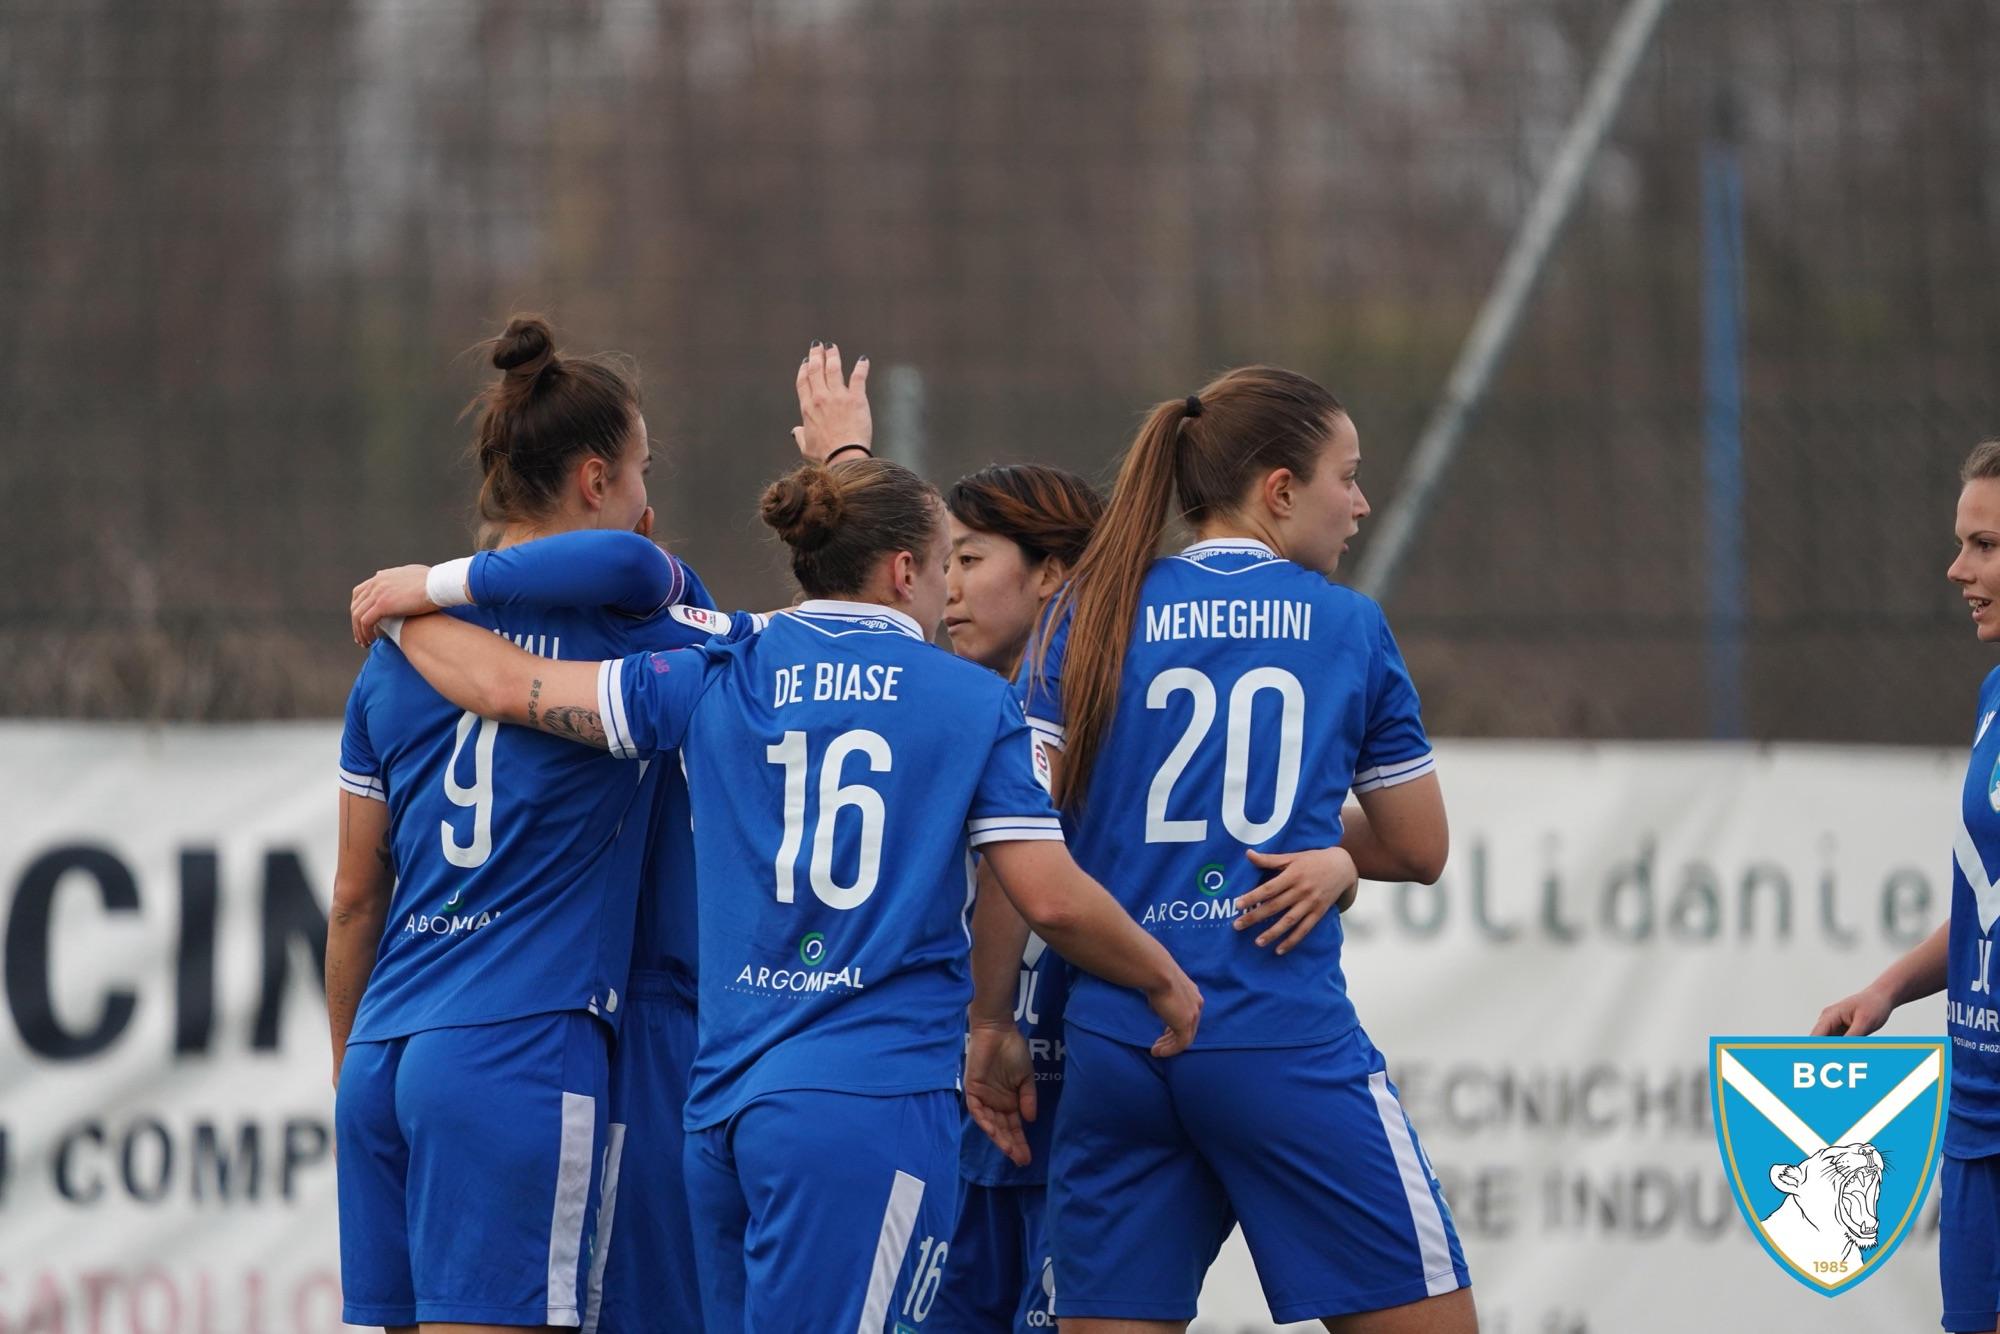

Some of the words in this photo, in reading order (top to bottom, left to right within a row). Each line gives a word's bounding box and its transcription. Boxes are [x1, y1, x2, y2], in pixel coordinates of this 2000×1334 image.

[1146, 601, 1311, 642] MENEGHINI
[774, 667, 803, 708] DE
[816, 664, 903, 701] BIASE
[441, 711, 499, 868] 9
[1145, 666, 1306, 846] 20
[766, 729, 893, 911] 16
[52, 1114, 333, 1211] COMP
[902, 1236, 948, 1323] 16
